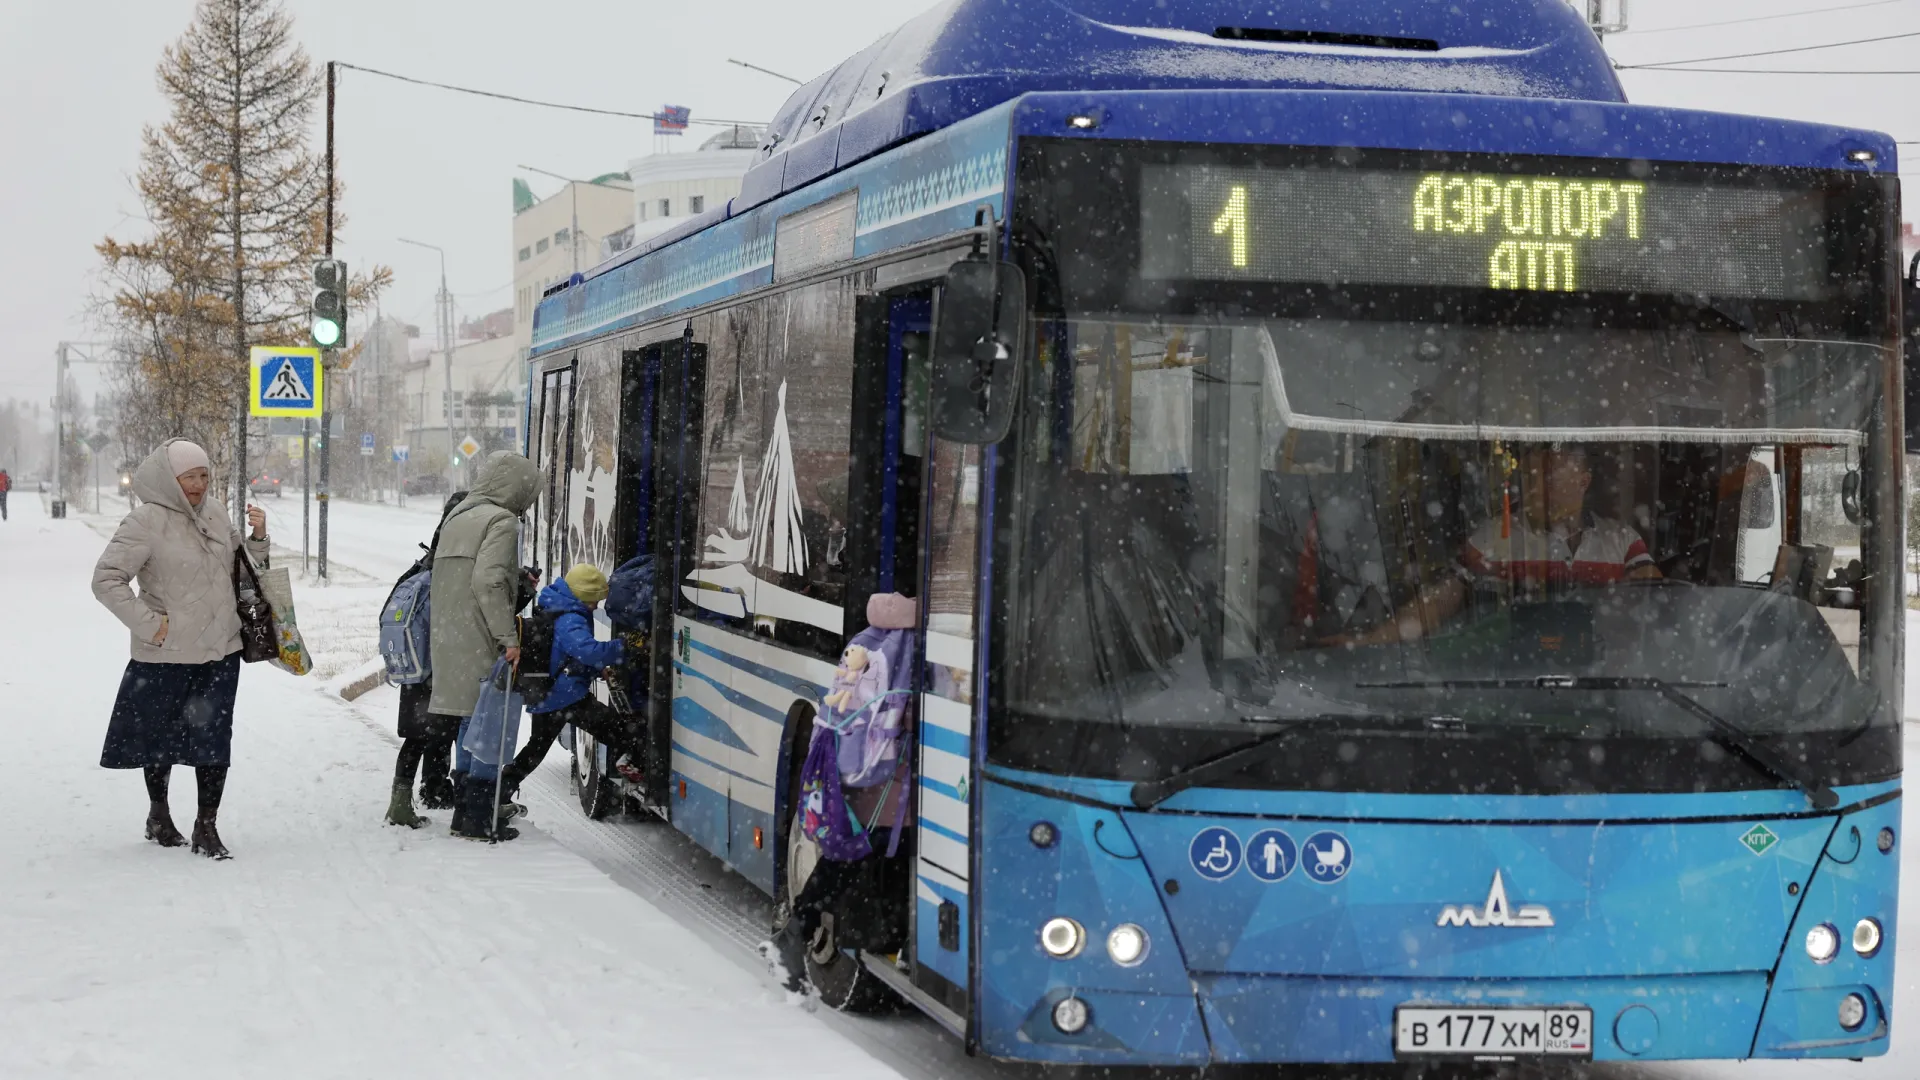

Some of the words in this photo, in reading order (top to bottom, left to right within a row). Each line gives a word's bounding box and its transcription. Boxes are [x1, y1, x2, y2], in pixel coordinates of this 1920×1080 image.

[1413, 175, 1645, 239] АЭРОПОРТ
[1213, 186, 1247, 267] 1
[1488, 240, 1576, 292] АТП
[1747, 833, 1771, 846] КПГ
[1546, 1040, 1569, 1048] RUS
[1549, 1014, 1580, 1038] 89
